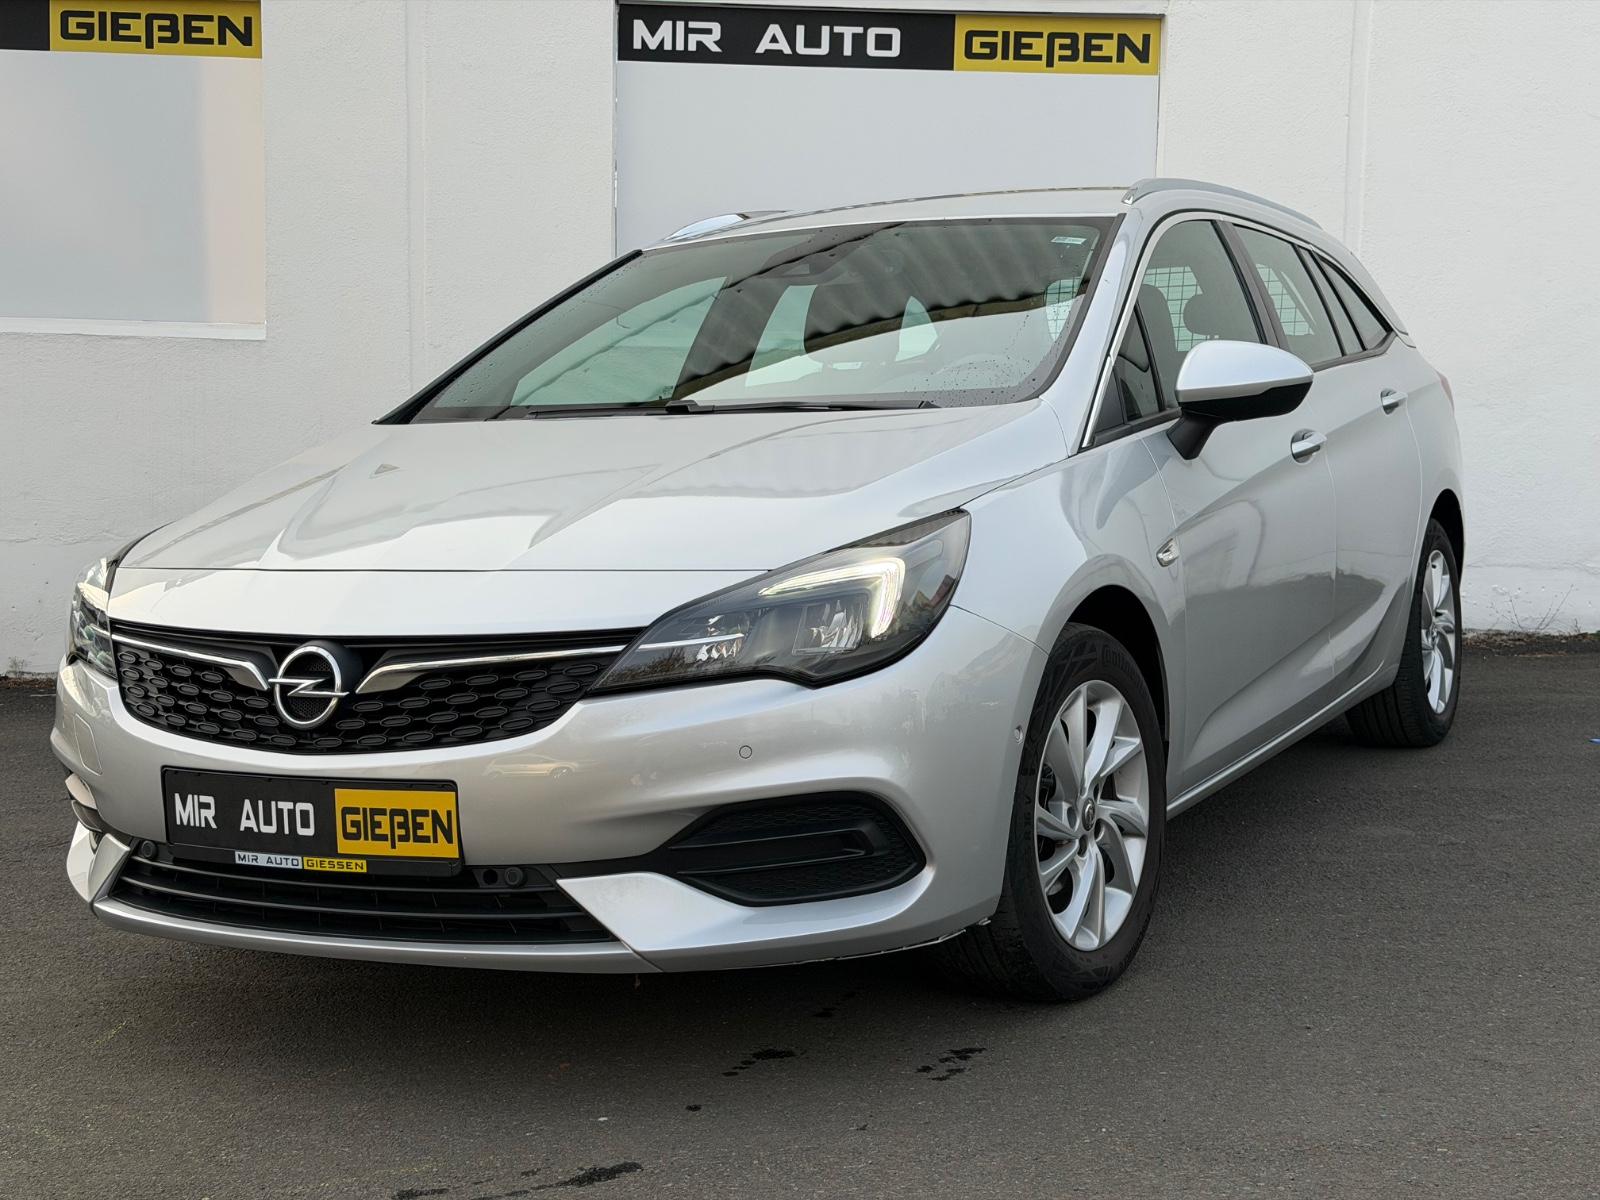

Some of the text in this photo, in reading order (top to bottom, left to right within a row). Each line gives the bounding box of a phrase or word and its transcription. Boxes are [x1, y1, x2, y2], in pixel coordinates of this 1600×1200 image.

[633, 19, 722, 52] MIR
[755, 24, 901, 58] AUTO
[174, 793, 217, 829] MIR
[240, 799, 315, 836] AUTO
[237, 853, 364, 870] MIR AUTO GIESSEN
